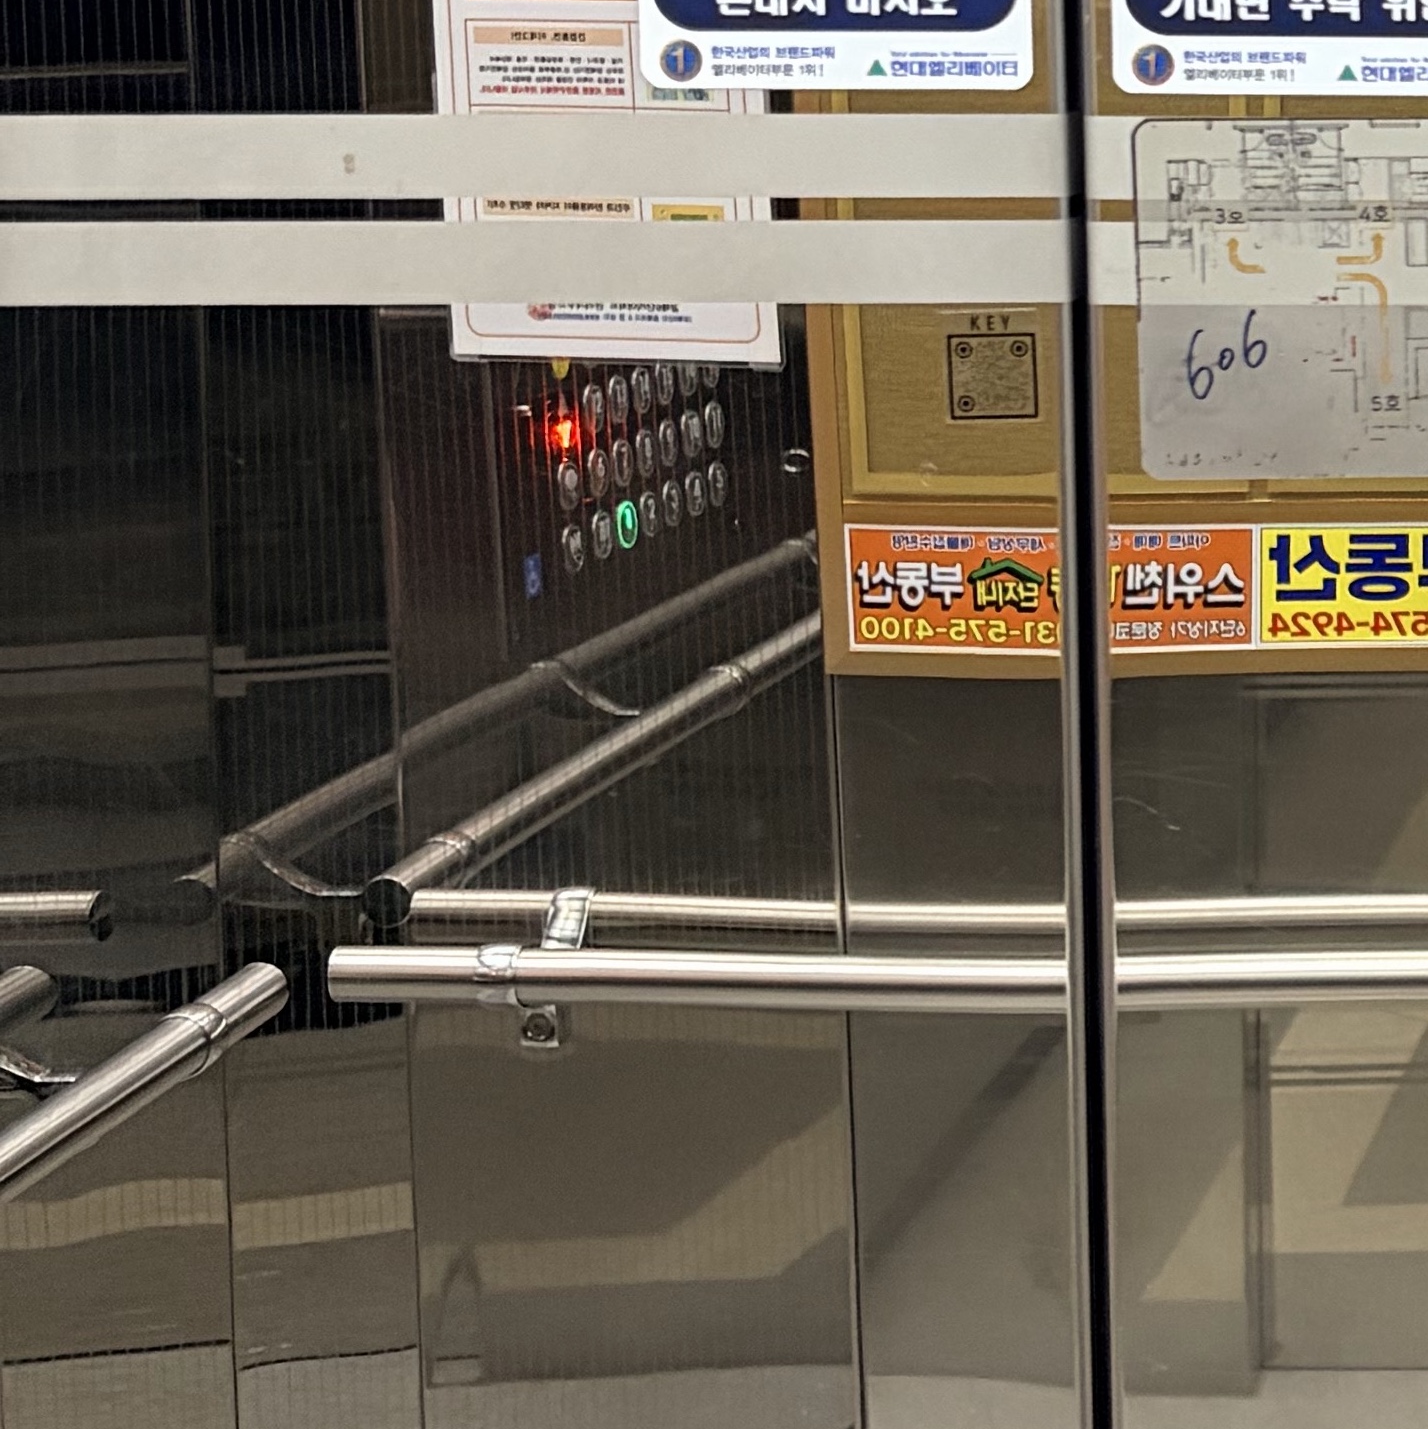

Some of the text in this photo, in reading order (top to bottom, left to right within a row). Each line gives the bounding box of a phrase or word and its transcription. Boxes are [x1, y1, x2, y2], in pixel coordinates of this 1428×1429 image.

[711, 45, 771, 60] 한국산업의
[1182, 50, 1307, 65] 한국산업의 브랜드파워
[890, 60, 1019, 78] 현대엘리베이터
[970, 314, 1011, 331] KEY
[1187, 308, 1267, 400] 606
